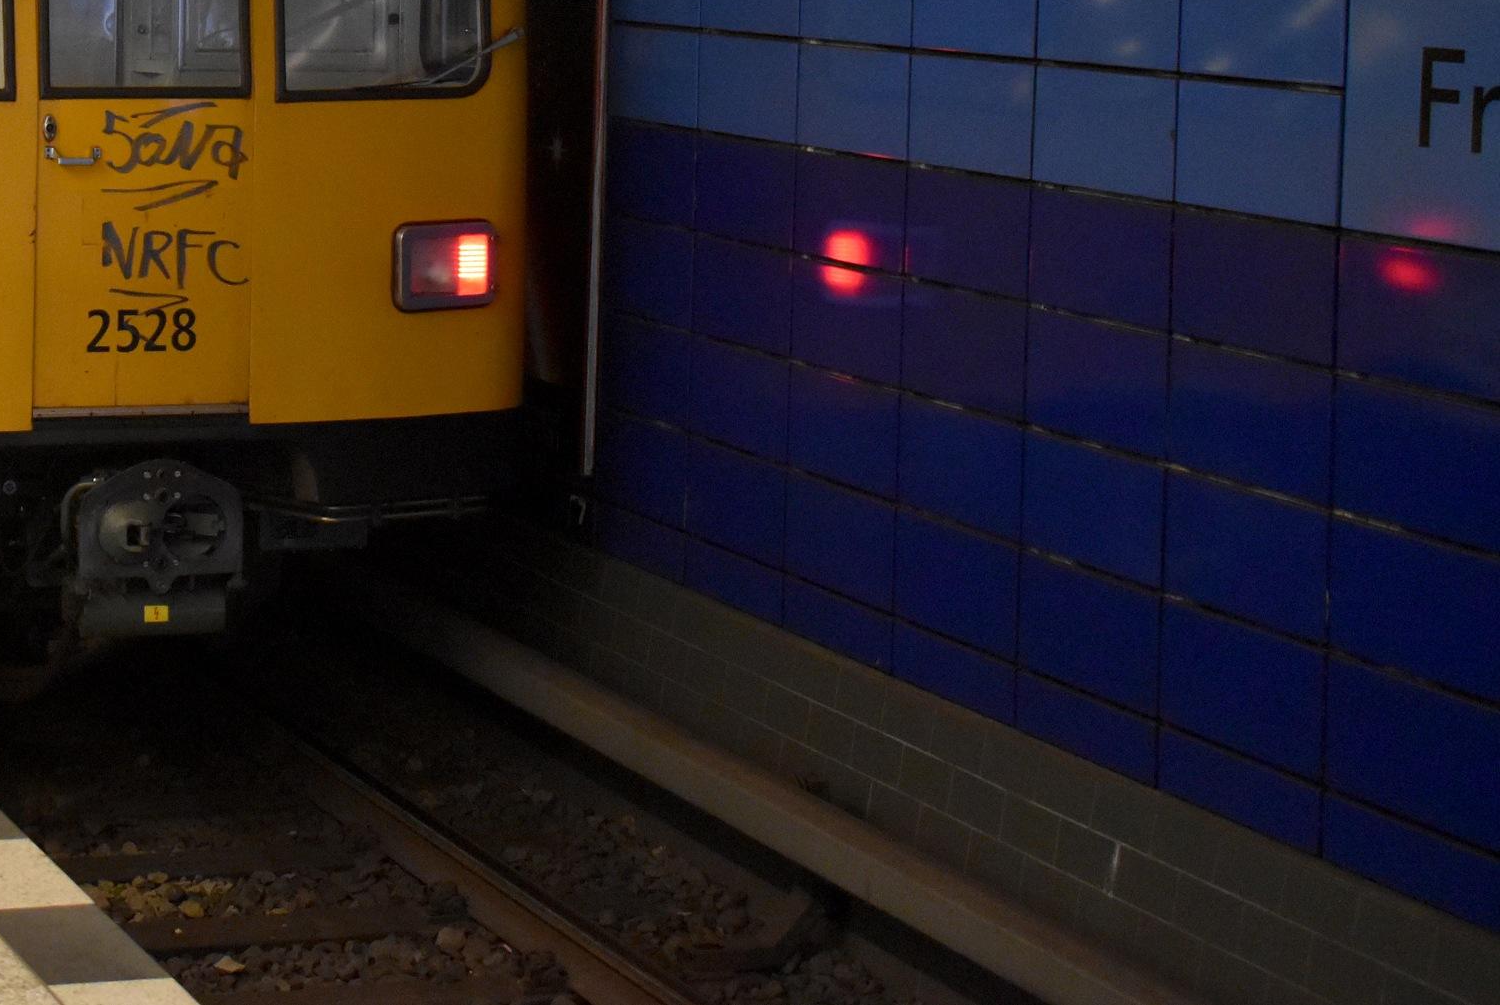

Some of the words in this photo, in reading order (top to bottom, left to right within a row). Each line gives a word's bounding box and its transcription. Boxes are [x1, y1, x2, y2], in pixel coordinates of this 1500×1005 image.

[1418, 46, 1500, 154] Fr
[101, 221, 249, 289] NRFC
[86, 308, 197, 353] 2528
